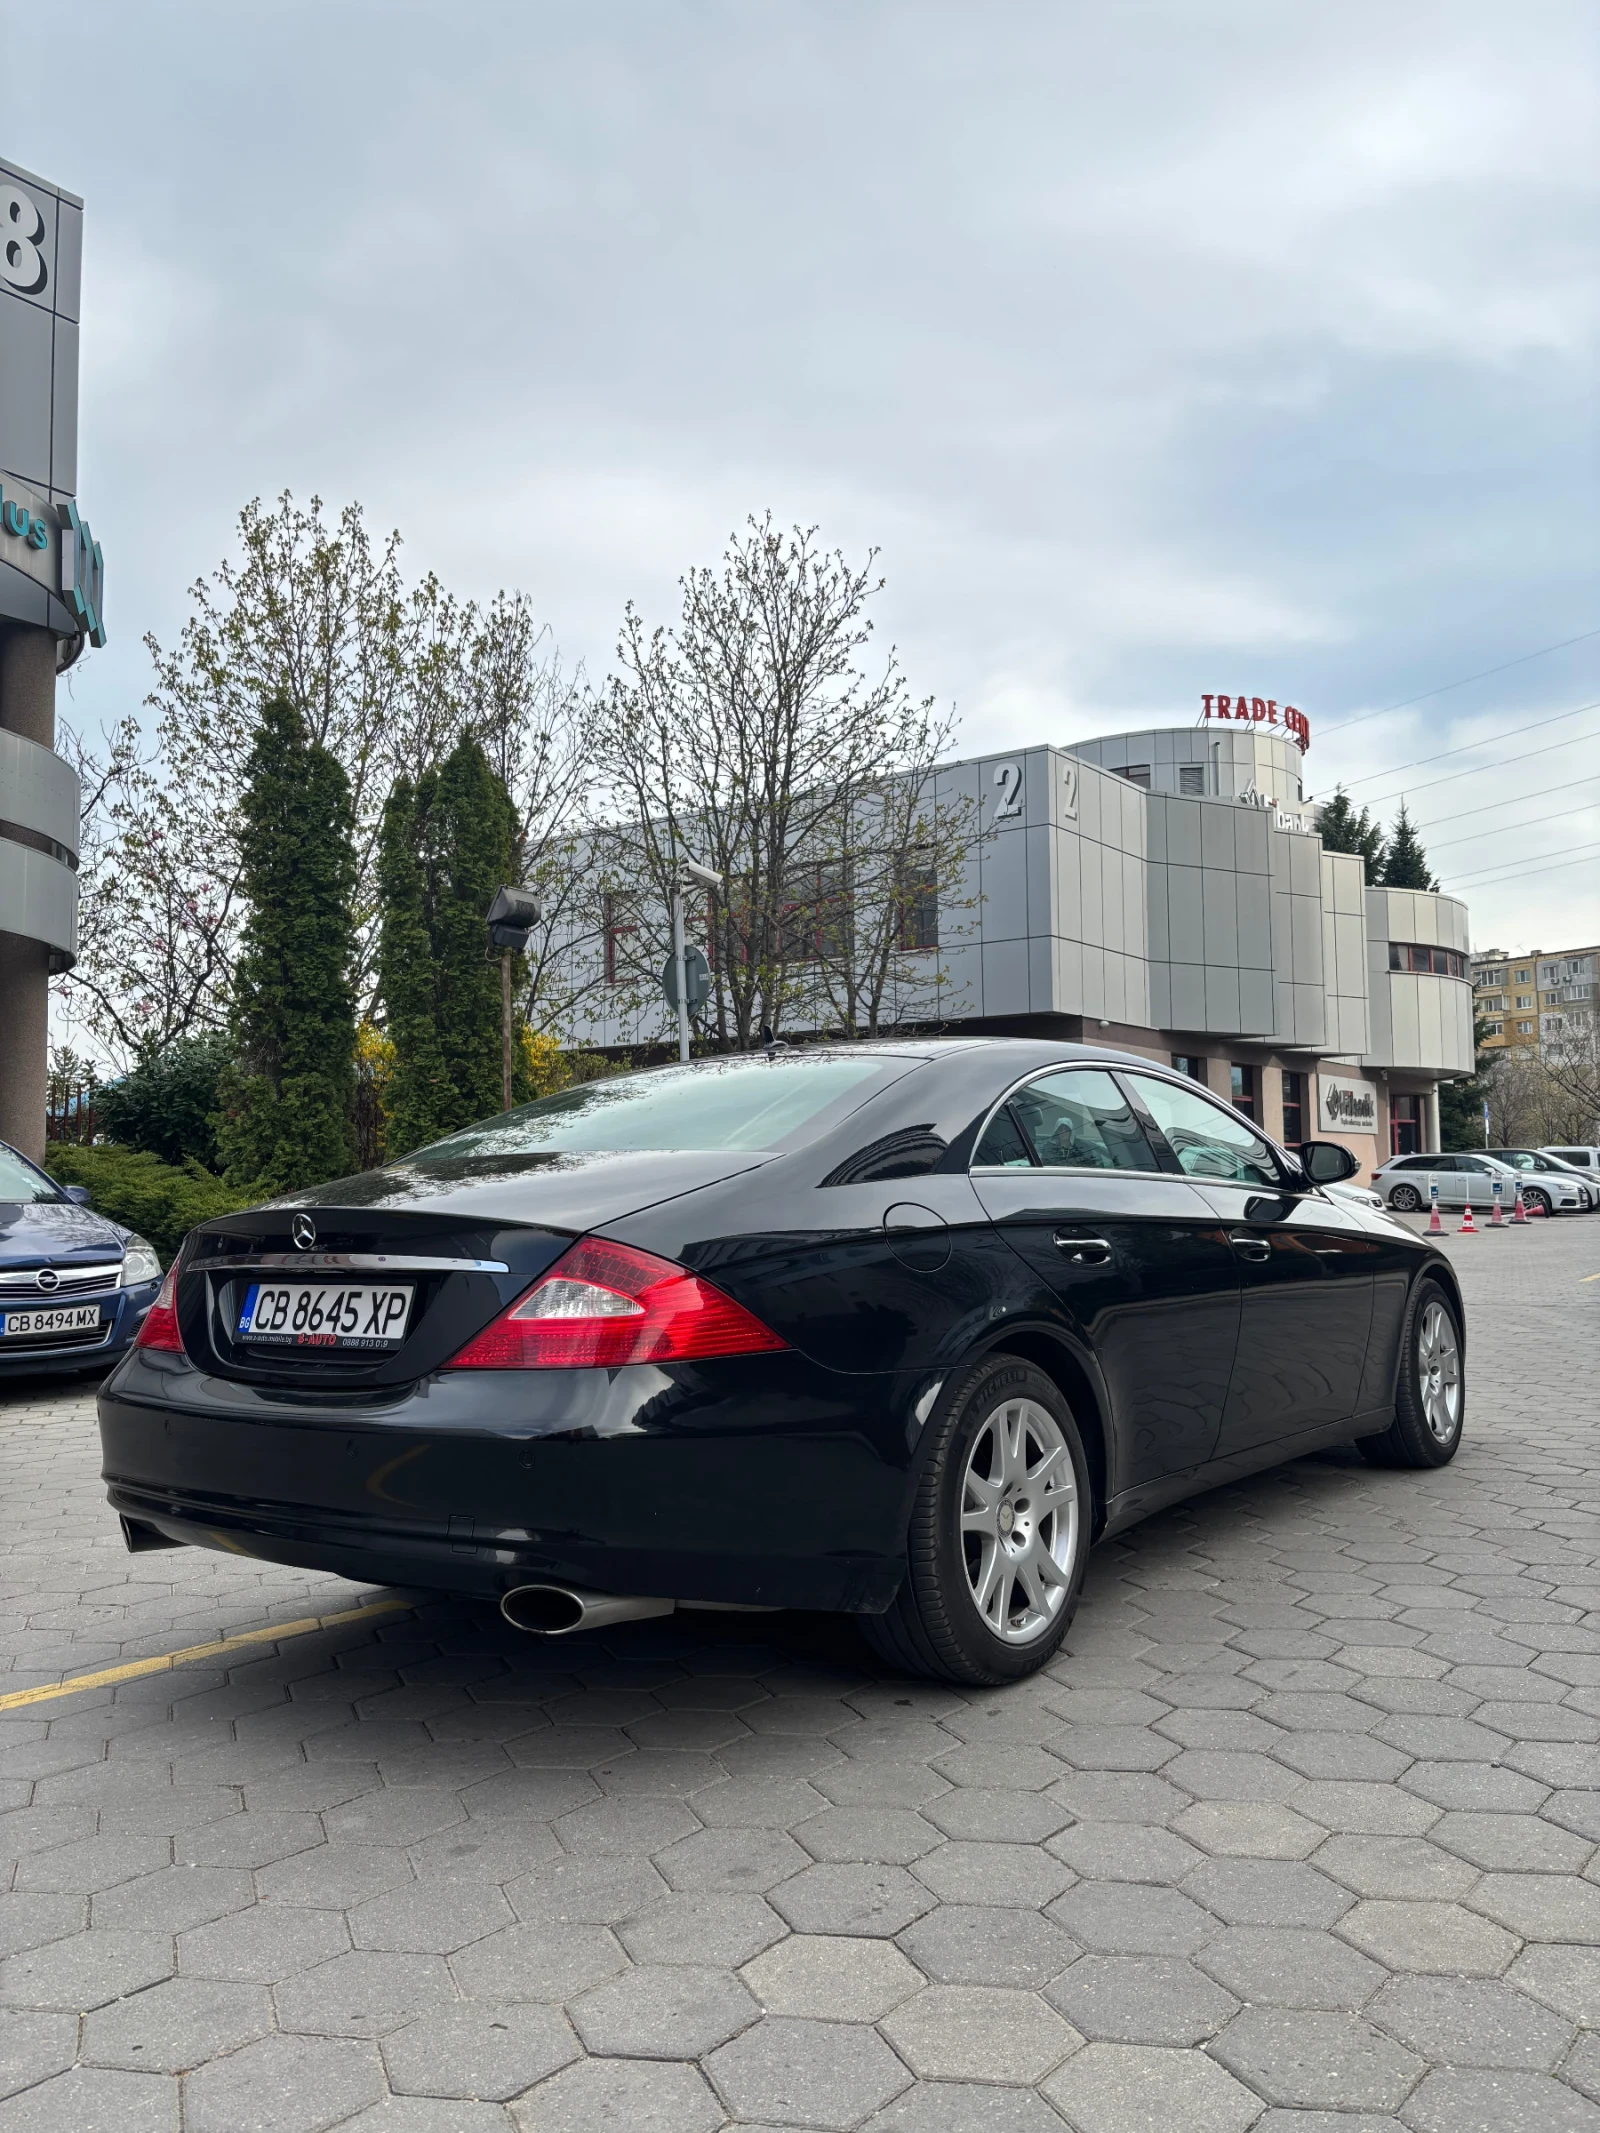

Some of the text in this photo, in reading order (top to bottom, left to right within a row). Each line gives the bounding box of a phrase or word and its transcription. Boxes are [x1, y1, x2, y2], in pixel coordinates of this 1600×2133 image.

[0, 184, 45, 293] 8
[1201, 694, 1278, 724] TRADE
[993, 763, 1021, 819] 2
[1062, 764, 1077, 821] 2
[7, 1309, 96, 1332] CB 8494 MX
[239, 1317, 250, 1329] BG
[255, 1290, 407, 1335] CB 8645 XP
[342, 1338, 360, 1346] 0888
[361, 1339, 374, 1347] 913
